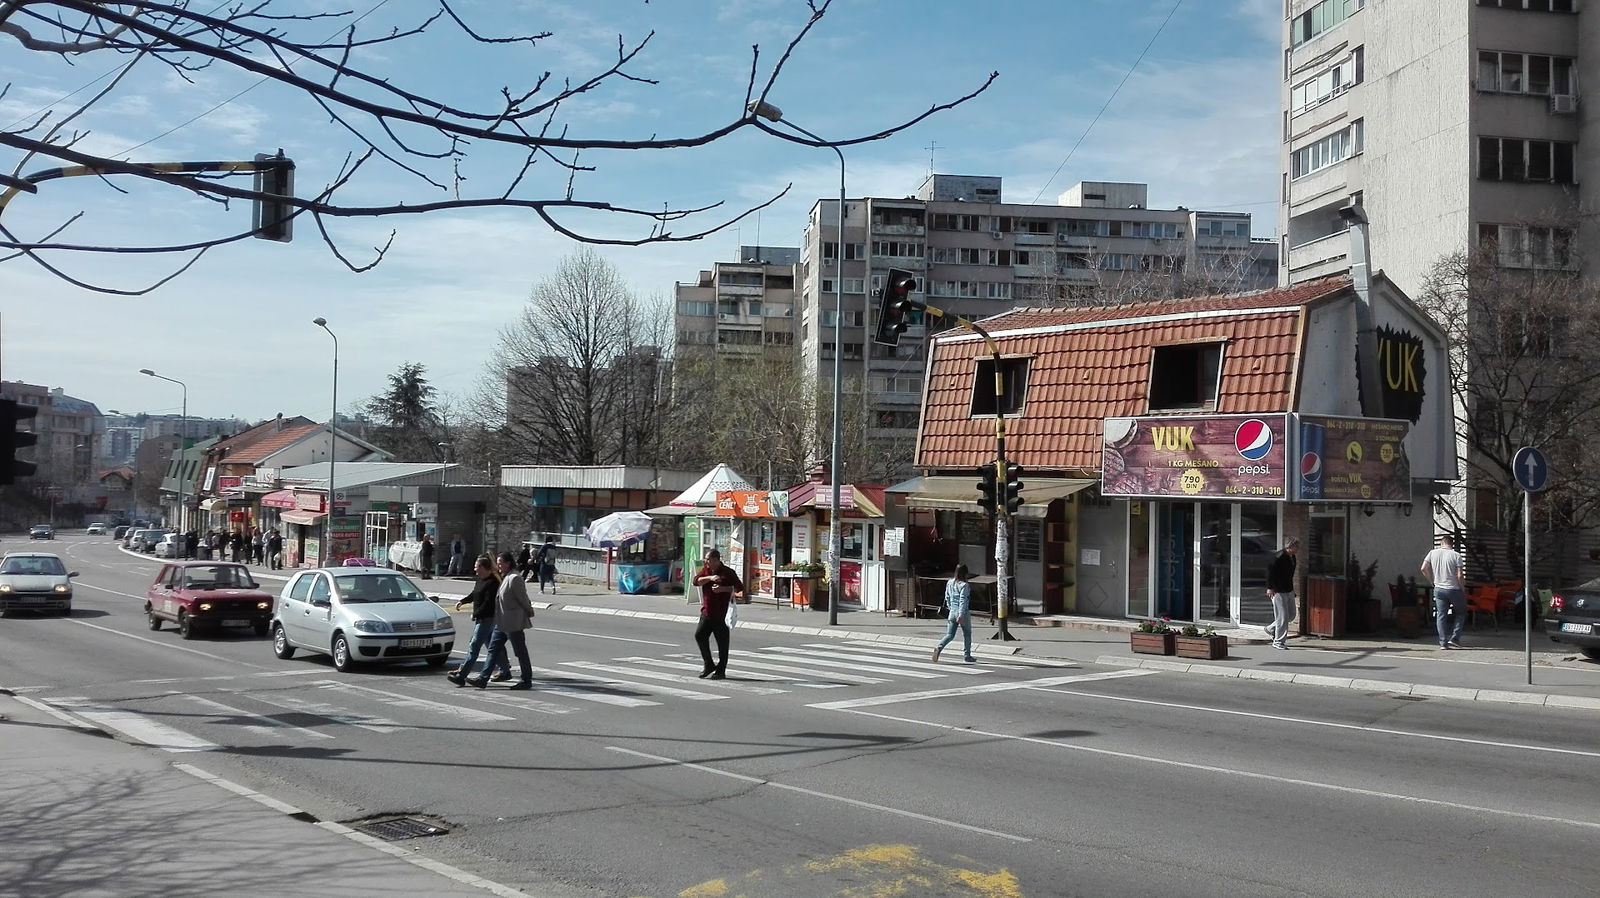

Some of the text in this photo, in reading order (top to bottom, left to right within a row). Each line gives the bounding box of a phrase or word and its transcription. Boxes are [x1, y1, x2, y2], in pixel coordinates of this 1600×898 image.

[1151, 426, 1195, 451] VUK
[1184, 459, 1219, 467] MEŠANO
[1238, 464, 1271, 476] pepsi
[1184, 475, 1201, 483] 790
[1348, 472, 1362, 483] VUK
